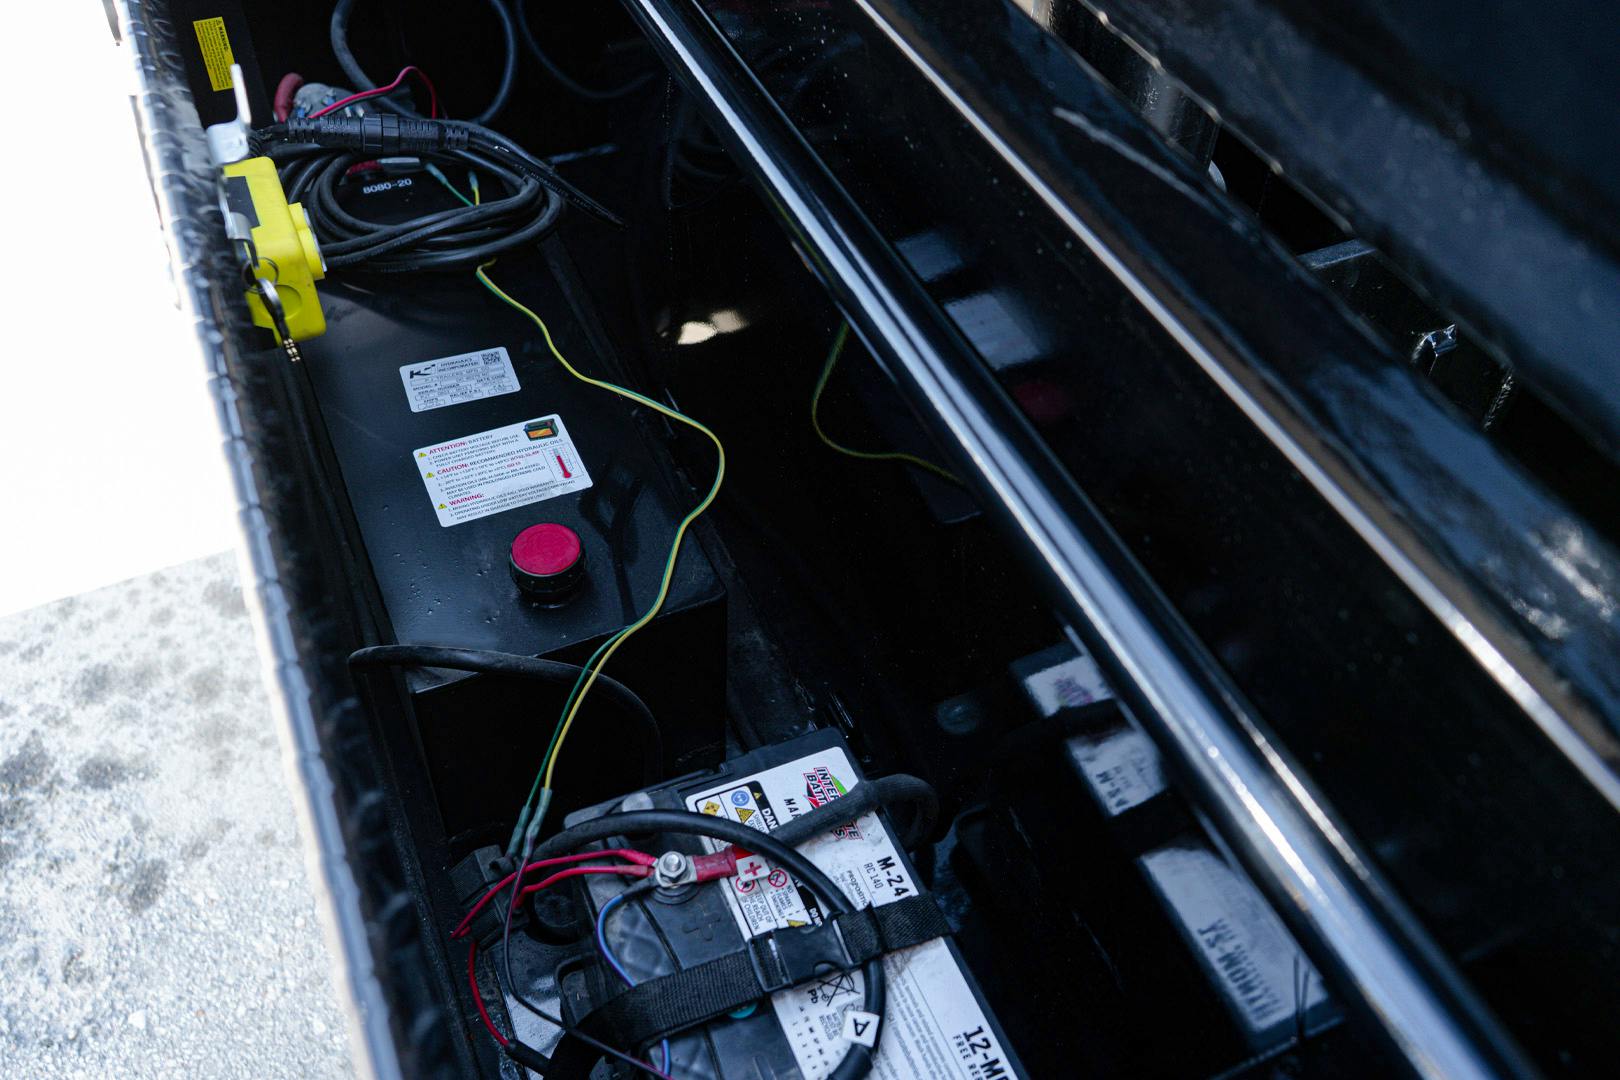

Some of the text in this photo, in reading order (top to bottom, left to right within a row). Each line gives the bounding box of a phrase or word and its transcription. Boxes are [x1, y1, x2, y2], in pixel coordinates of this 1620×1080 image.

[428, 440, 466, 455] ATTENTION:
[436, 462, 469, 475] CAUTION:
[448, 492, 484, 506] WARNING:
[806, 988, 820, 1004] Pb
[852, 1018, 870, 1037] A
